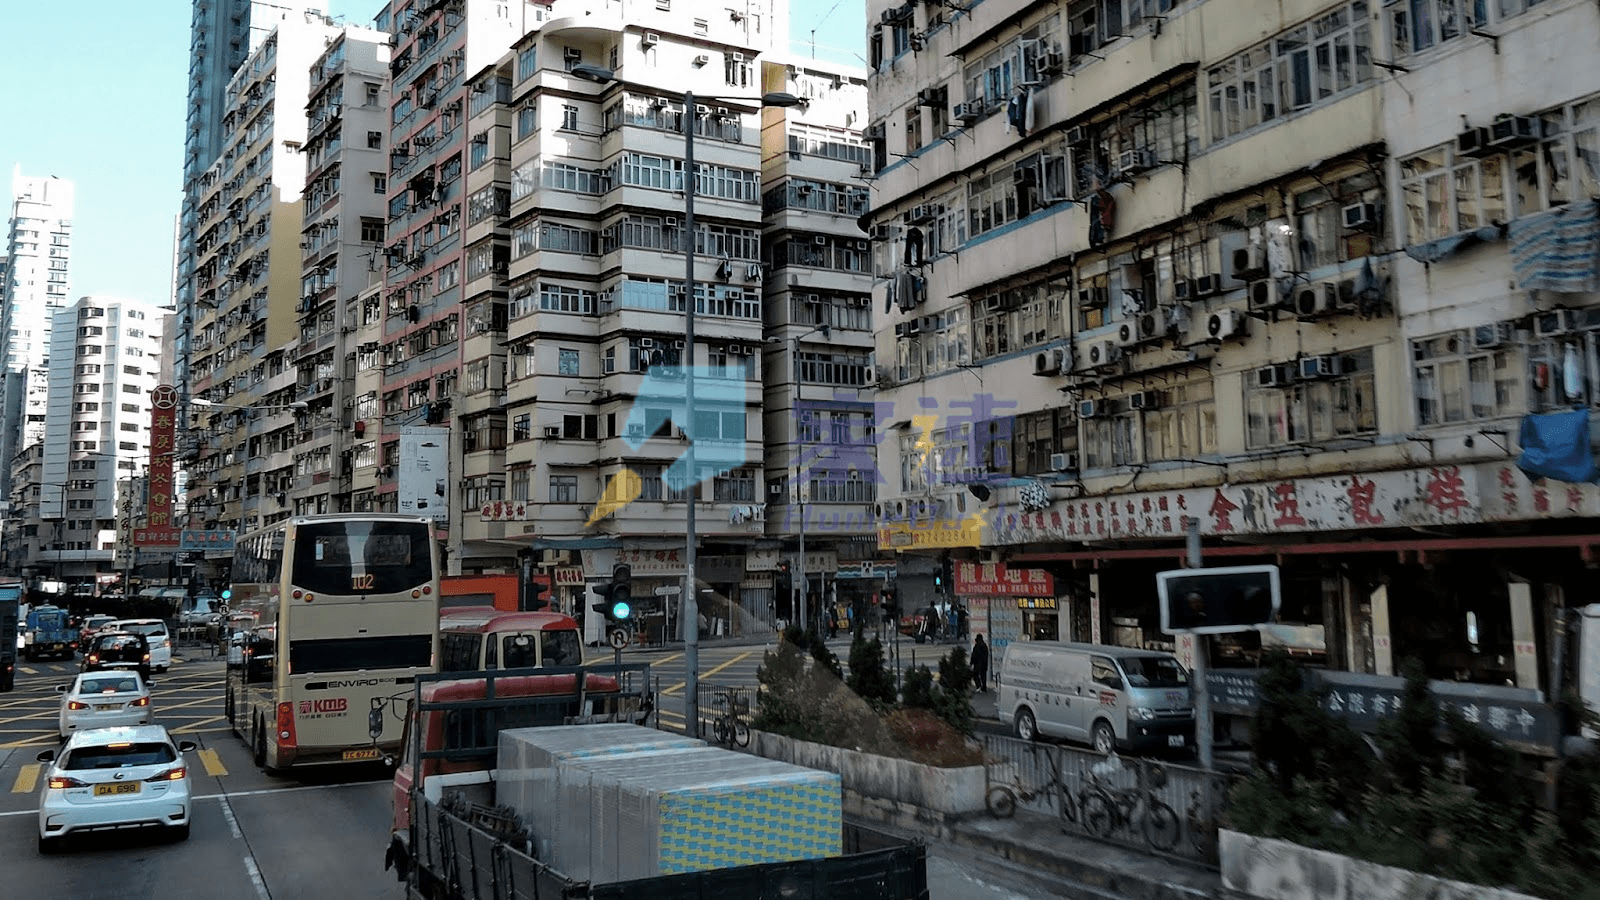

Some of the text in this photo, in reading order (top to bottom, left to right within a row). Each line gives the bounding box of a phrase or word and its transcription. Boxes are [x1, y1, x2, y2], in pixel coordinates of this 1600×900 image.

[352, 574, 373, 590] 102
[328, 679, 378, 689] ENVIRO
[314, 698, 348, 713] KMB
[99, 784, 136, 795] DA 698
